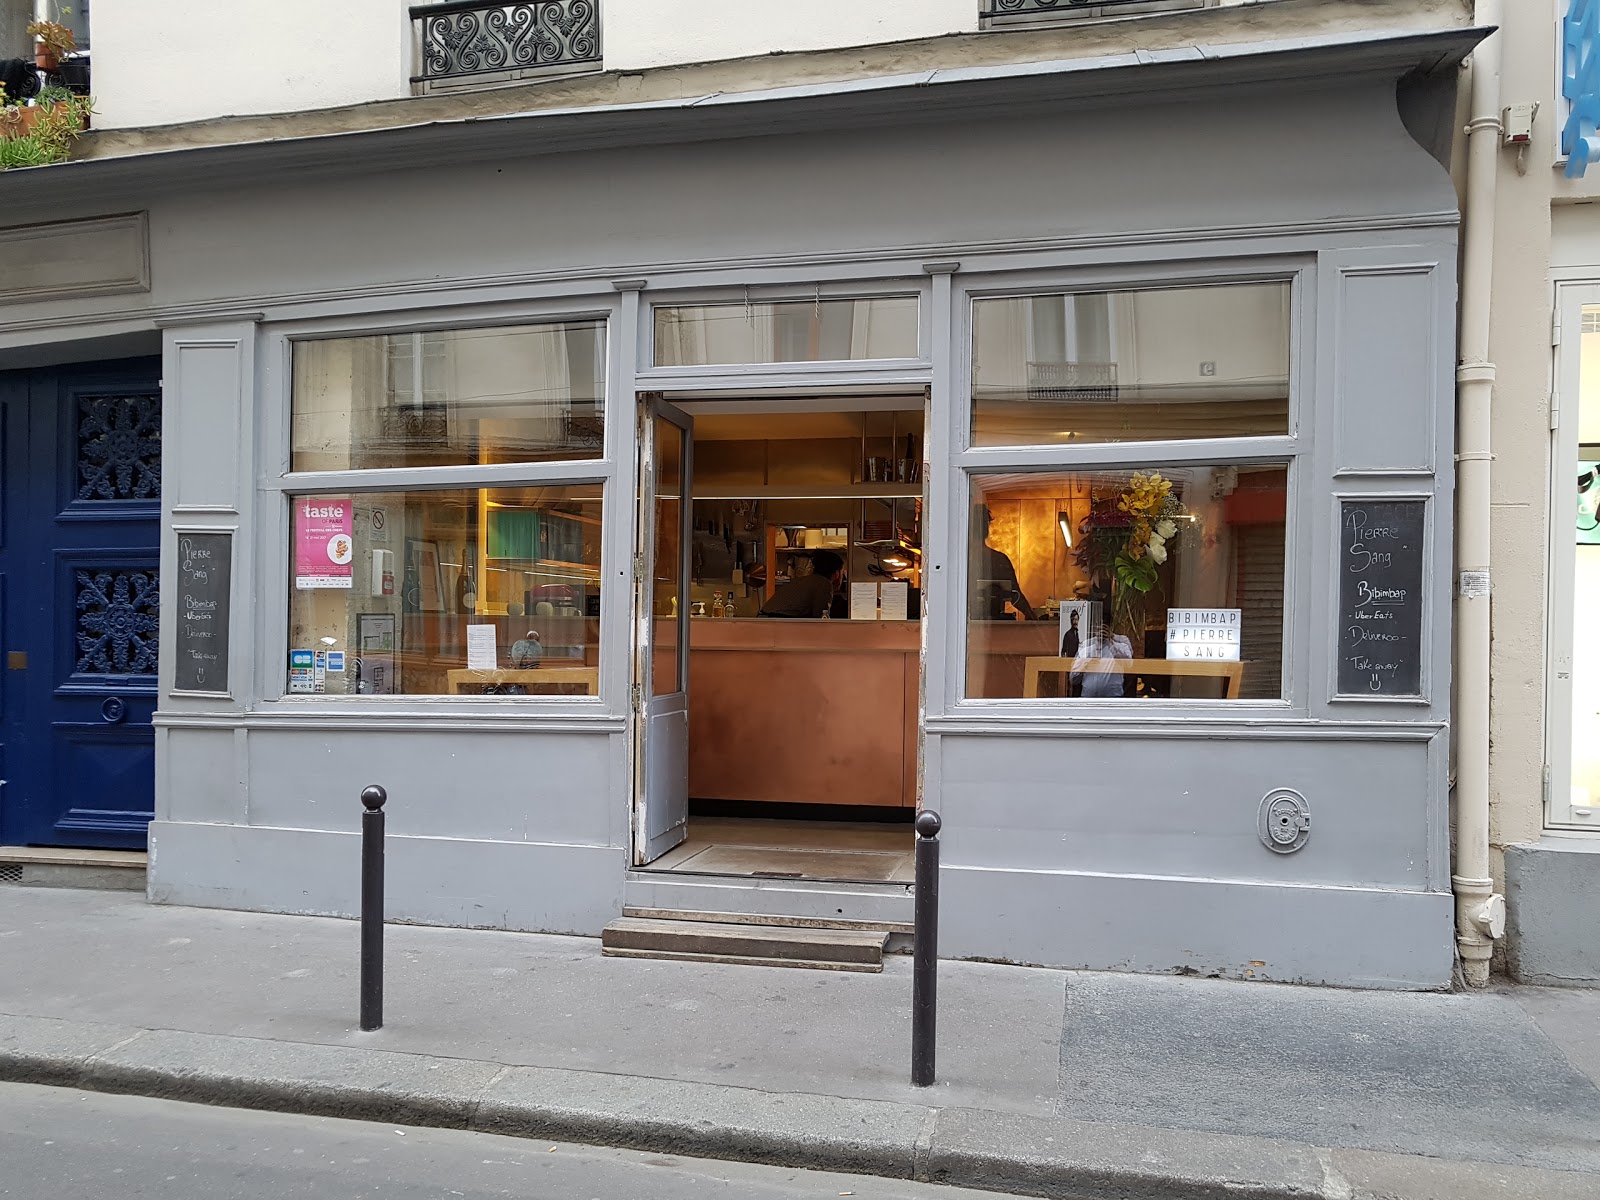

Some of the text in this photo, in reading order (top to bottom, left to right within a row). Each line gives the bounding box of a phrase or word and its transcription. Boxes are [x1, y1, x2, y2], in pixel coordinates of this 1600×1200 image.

[304, 504, 344, 518] taste
[1346, 509, 1399, 545] Pierre
[1350, 543, 1391, 573] Sang
[1355, 580, 1407, 608] Bibimbap
[1168, 612, 1236, 624] BIBIMBAP
[1184, 646, 1225, 658] SANG
